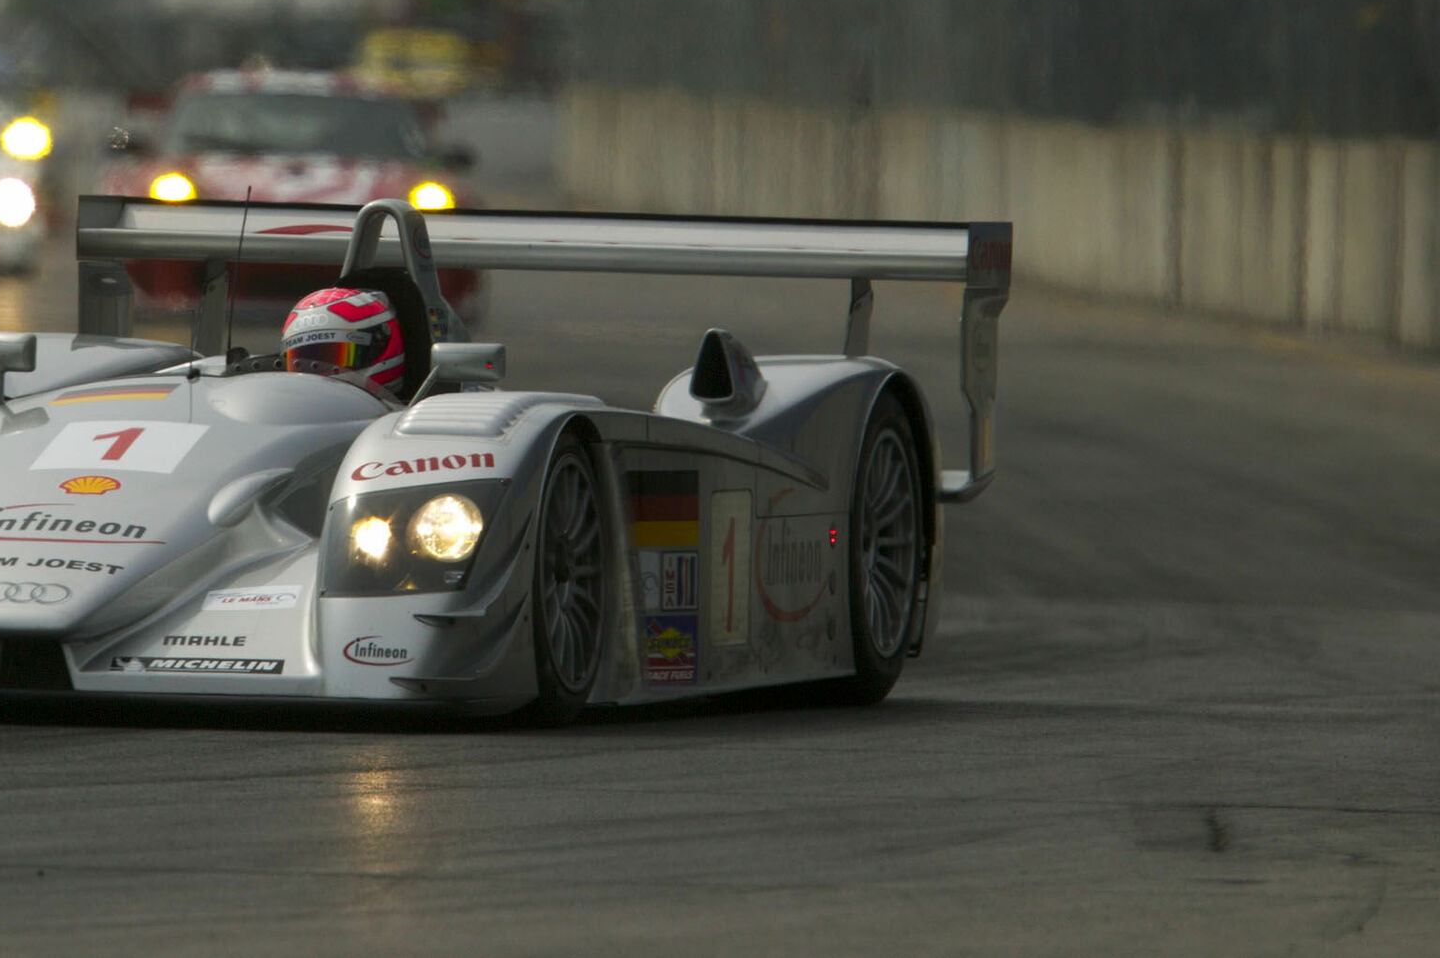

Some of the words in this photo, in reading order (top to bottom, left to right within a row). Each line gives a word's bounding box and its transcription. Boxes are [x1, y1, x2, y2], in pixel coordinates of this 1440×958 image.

[92, 427, 146, 461] 1
[351, 453, 495, 482] Canon
[27, 558, 124, 575] JOEST
[721, 516, 736, 633] 1
[163, 635, 247, 647] MAHLE
[149, 658, 278, 671] MICHELIN
